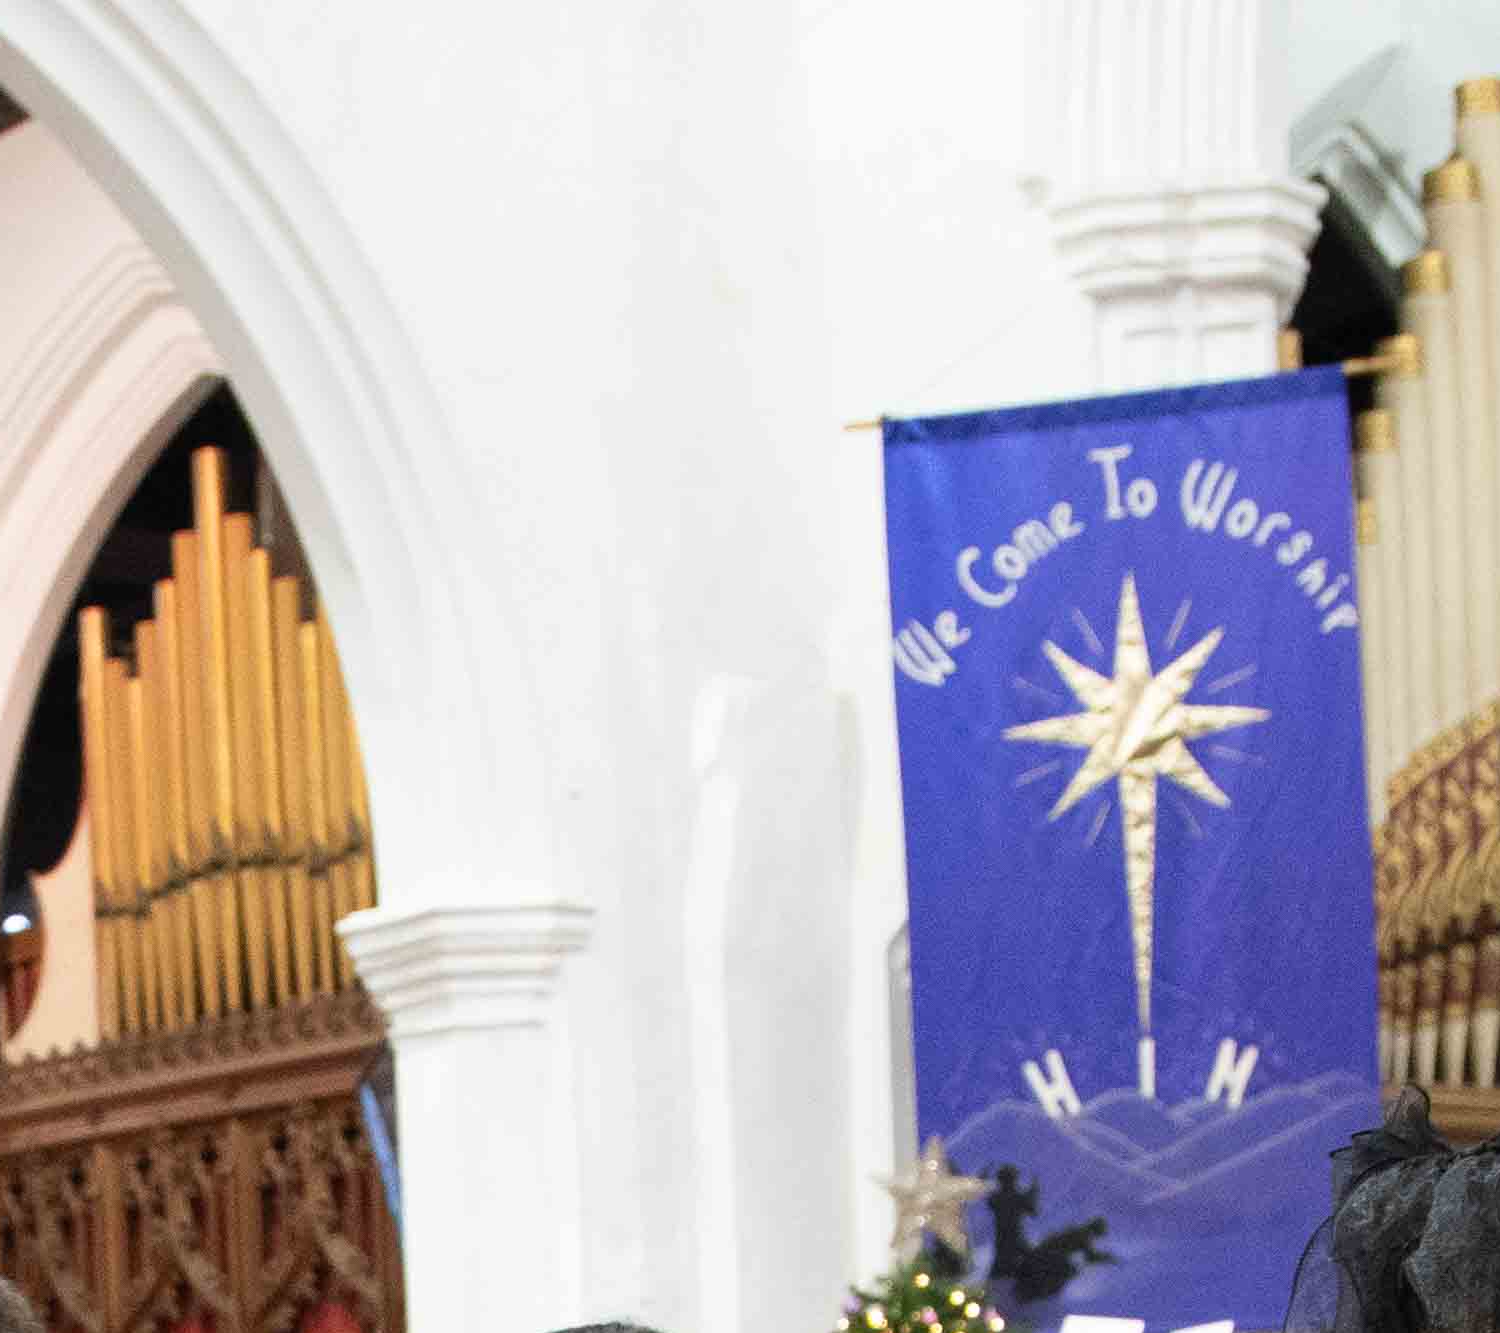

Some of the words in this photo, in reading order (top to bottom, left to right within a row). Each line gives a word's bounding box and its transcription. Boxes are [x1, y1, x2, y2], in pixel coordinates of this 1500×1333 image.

[894, 610, 971, 686] We
[956, 501, 1085, 607] Come
[1088, 443, 1158, 520] To
